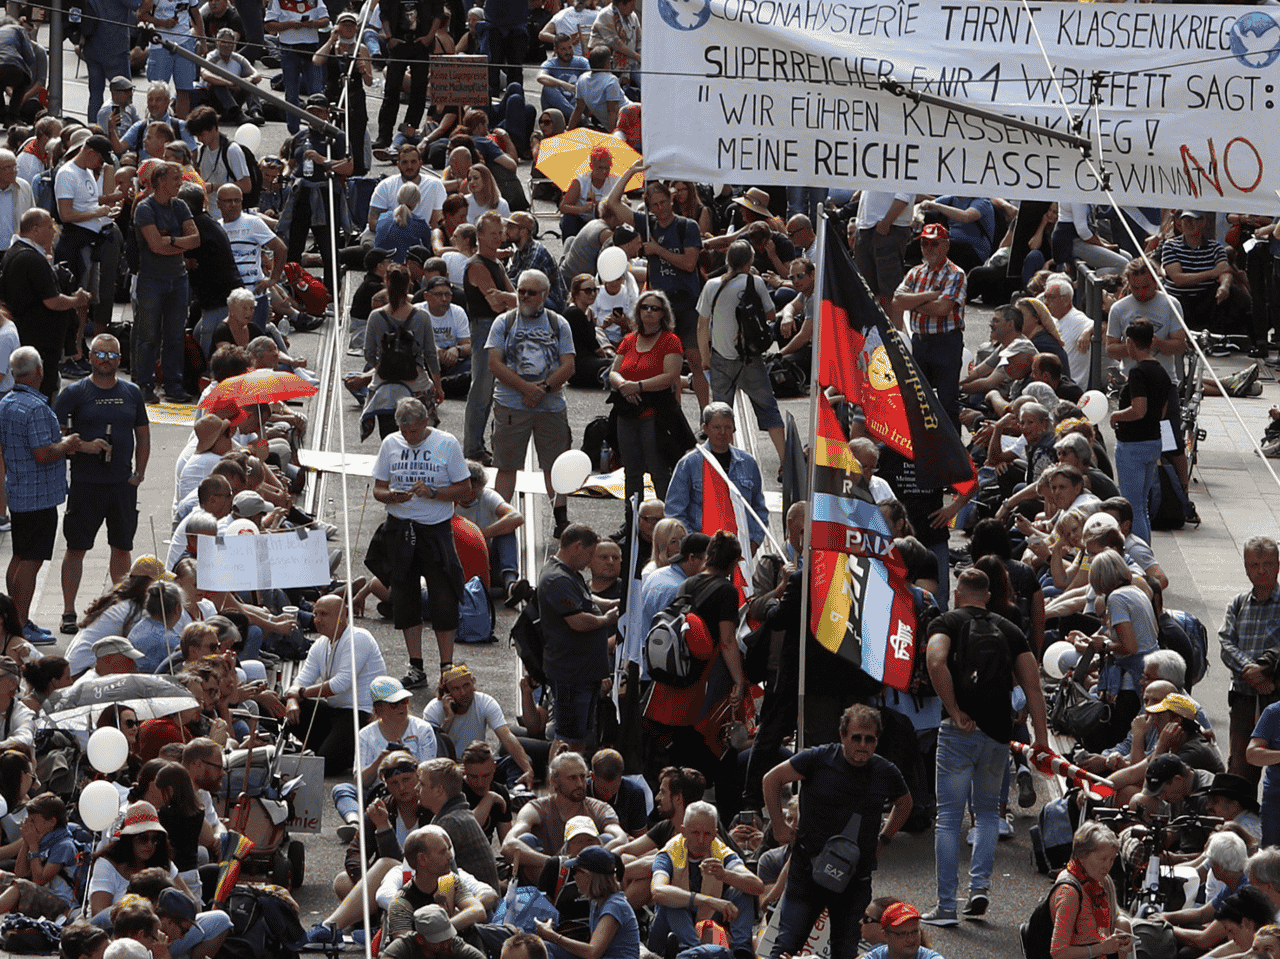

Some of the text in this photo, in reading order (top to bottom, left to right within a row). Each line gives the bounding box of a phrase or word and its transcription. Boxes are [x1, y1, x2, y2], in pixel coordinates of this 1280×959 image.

[939, 5, 1041, 45] TARNT
[789, 92, 879, 132] FÜHREN
[717, 133, 798, 173] MEINE
[813, 138, 918, 181] REICHE
[937, 144, 1061, 190] KLASSE
[1179, 136, 1264, 198] NO
[845, 529, 895, 559] PAIX
